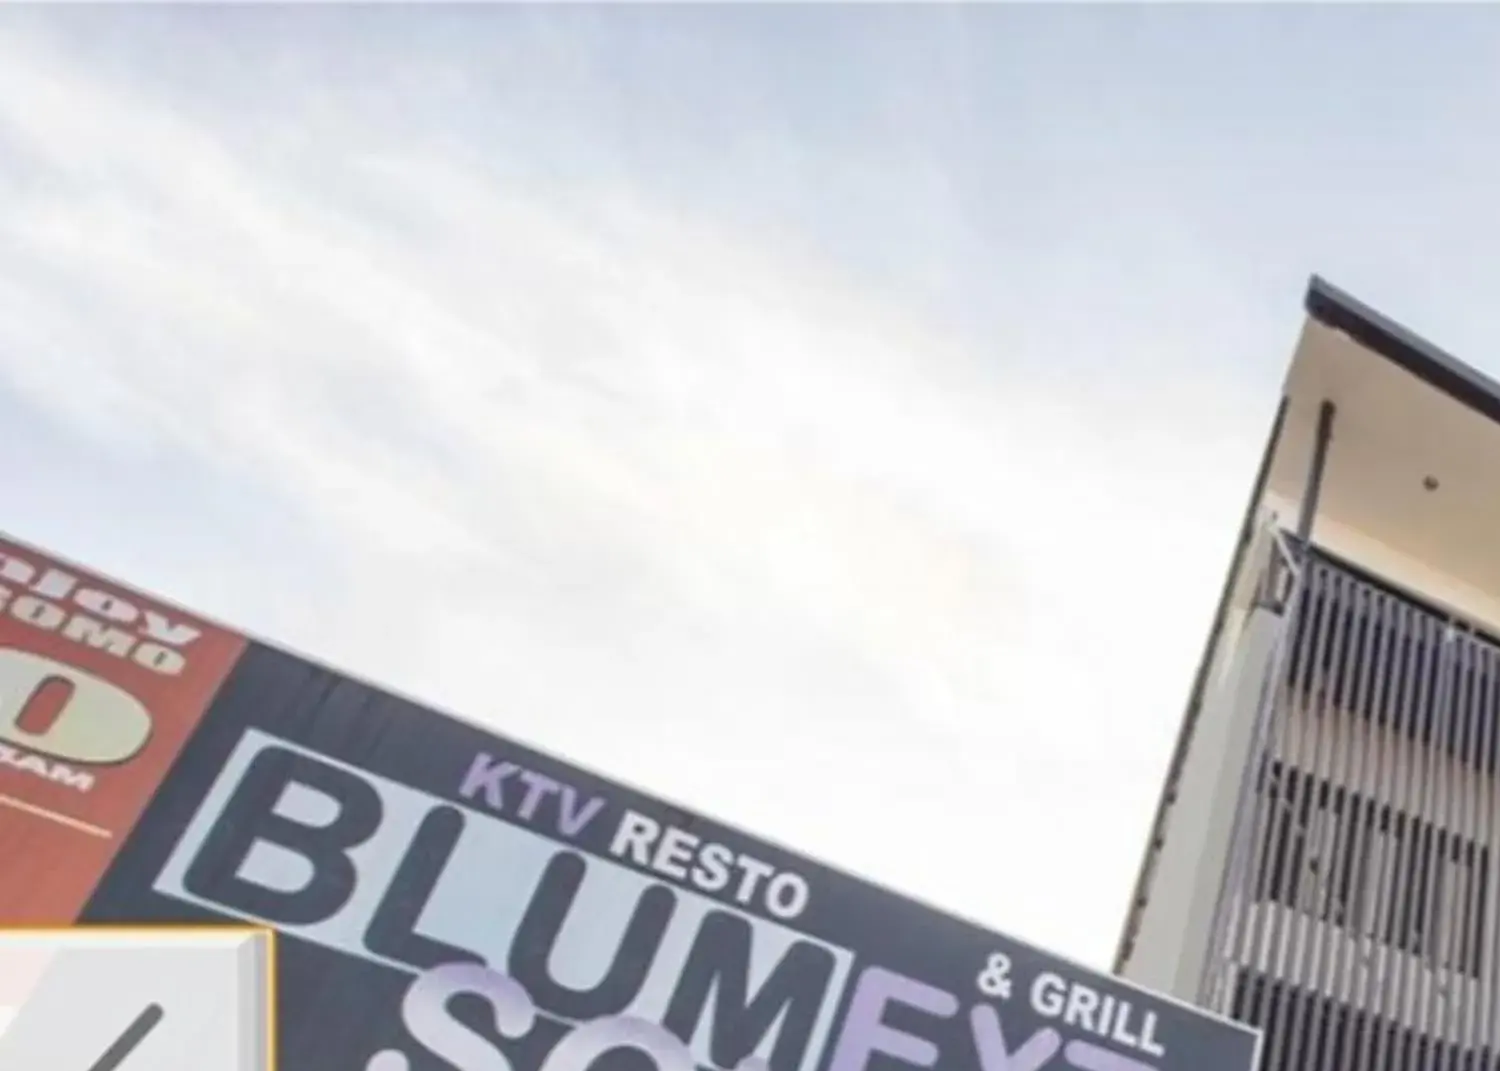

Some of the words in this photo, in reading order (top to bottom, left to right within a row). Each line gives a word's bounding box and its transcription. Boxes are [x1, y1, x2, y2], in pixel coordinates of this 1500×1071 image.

[0, 584, 186, 676] OMO
[459, 753, 603, 837] KTV
[610, 810, 810, 918] RESTO
[976, 951, 1011, 999] &
[1029, 972, 1165, 1056] GRILL
